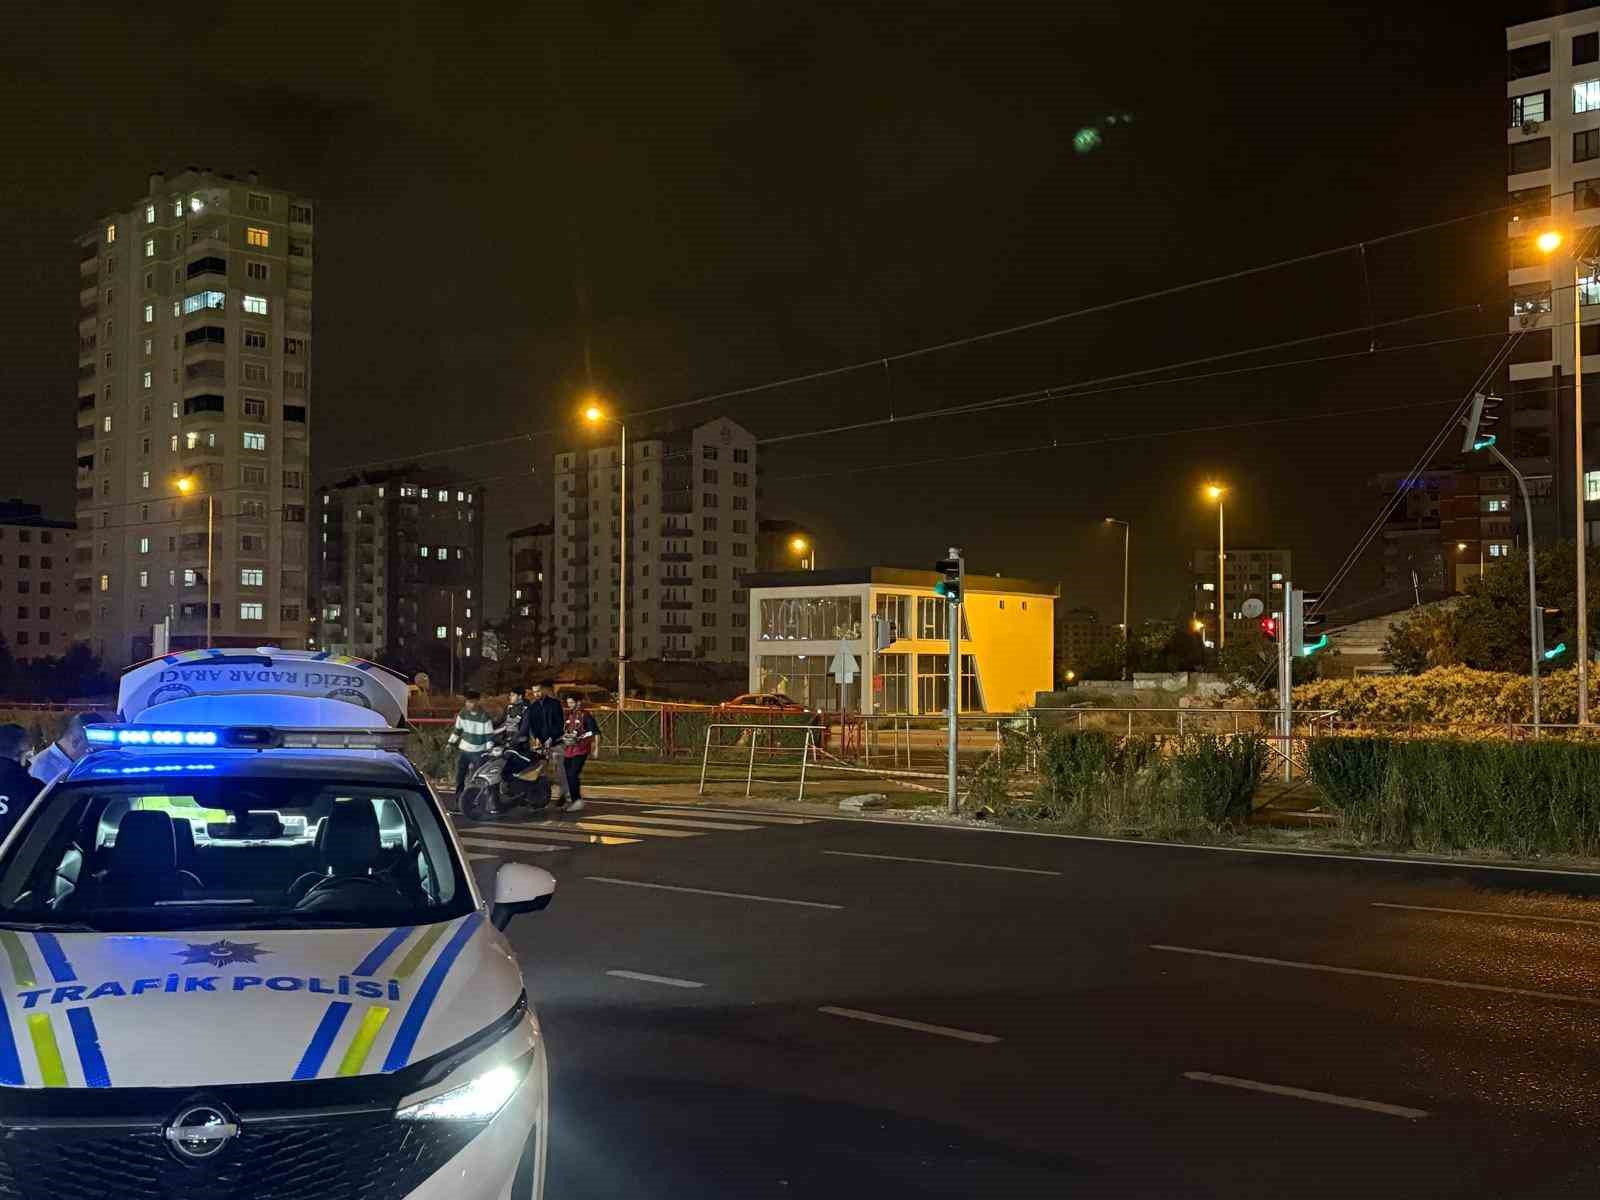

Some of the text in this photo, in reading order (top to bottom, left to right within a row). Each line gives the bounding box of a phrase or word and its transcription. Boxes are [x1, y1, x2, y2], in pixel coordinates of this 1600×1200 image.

[159, 669, 223, 683] ARACI
[230, 670, 297, 683] RADAR
[17, 972, 402, 1009] TRAFİK POLİSİ
